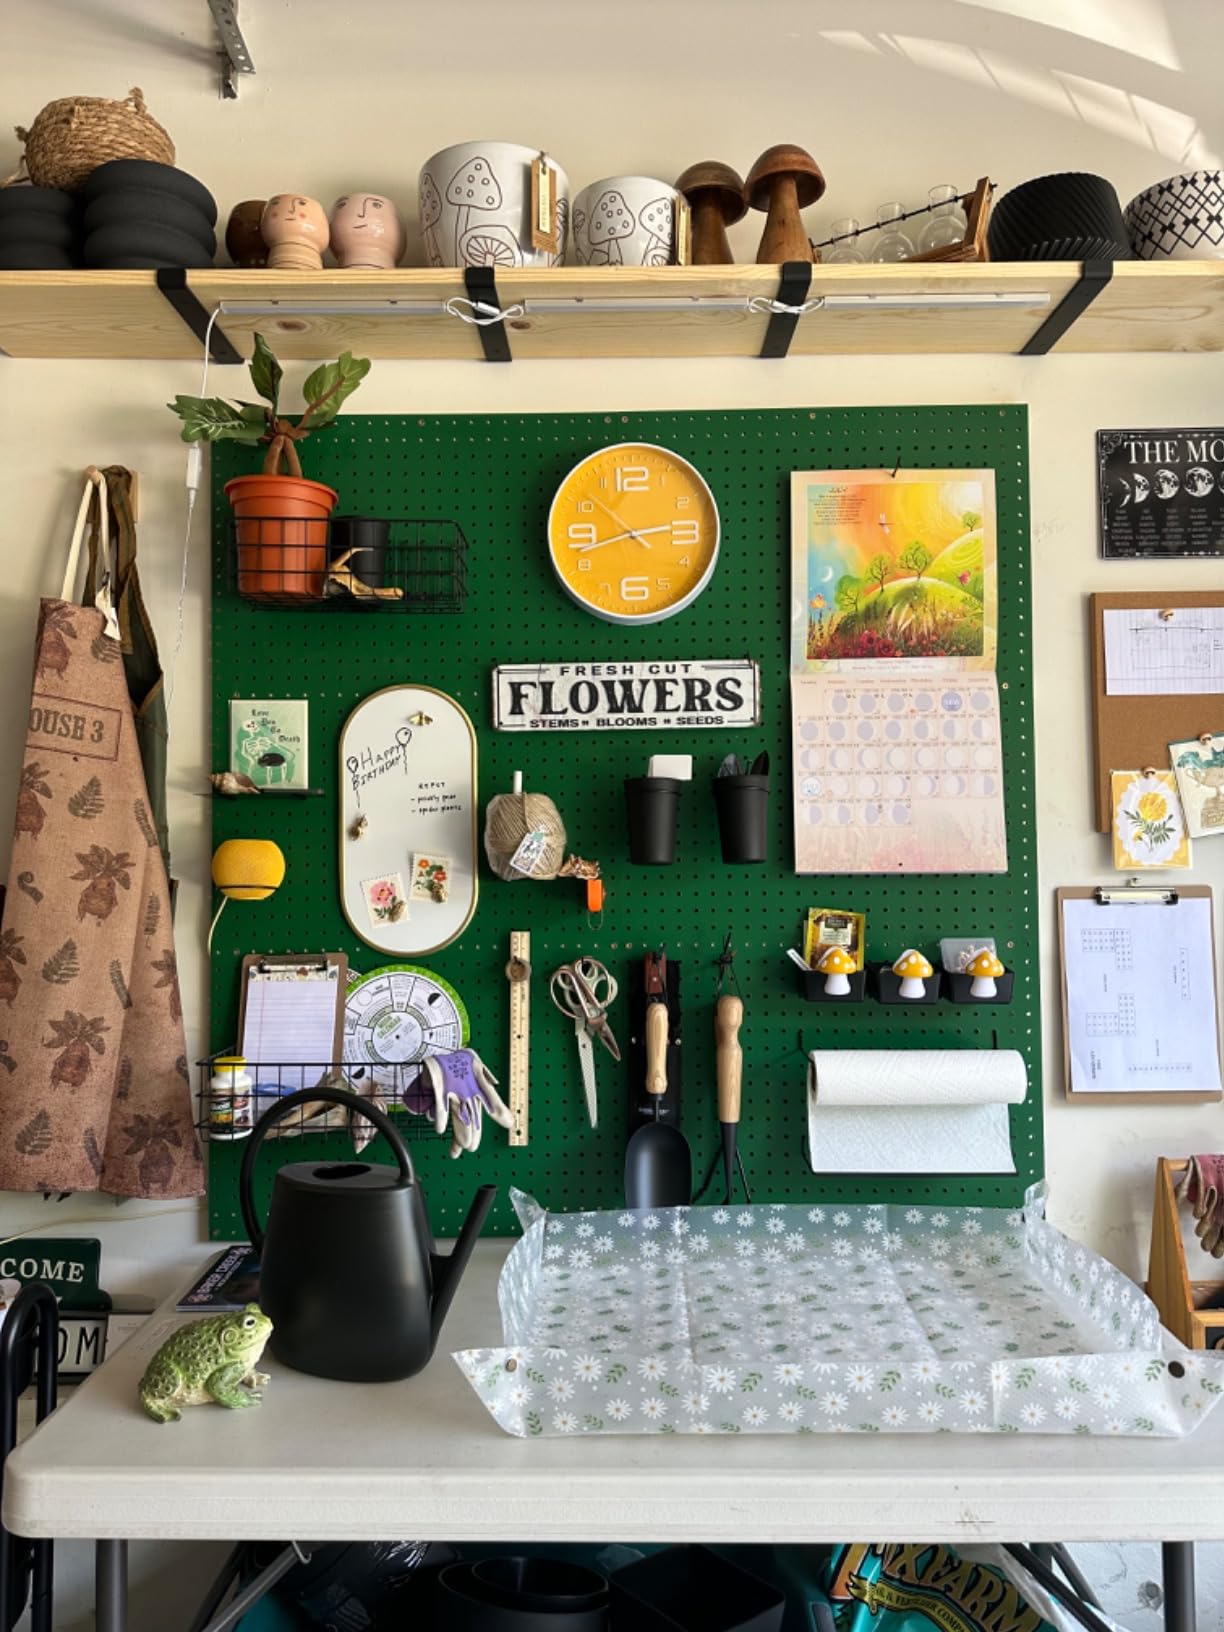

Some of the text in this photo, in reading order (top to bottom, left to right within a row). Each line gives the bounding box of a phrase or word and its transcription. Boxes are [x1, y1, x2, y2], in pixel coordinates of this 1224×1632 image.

[1124, 439, 1224, 464] THE MO
[599, 477, 607, 489] 11
[615, 467, 649, 492] 12
[577, 501, 594, 513] 10
[676, 496, 690, 509] 2
[568, 523, 597, 549] 9
[672, 520, 699, 545] 3
[578, 559, 591, 571] 8
[679, 555, 690, 568] 4
[600, 583, 612, 595] 7
[620, 576, 649, 601] 6
[657, 578, 671, 590] 5
[560, 664, 693, 676] FRESH CUT
[508, 677, 744, 716] FLOWERS
[529, 716, 725, 728] STEMS BLOOMS SEEDS
[90, 720, 105, 743] 3
[278, 735, 301, 743] Death
[351, 754, 401, 791] BIRTHDAY
[0, 1257, 85, 1283] COME
